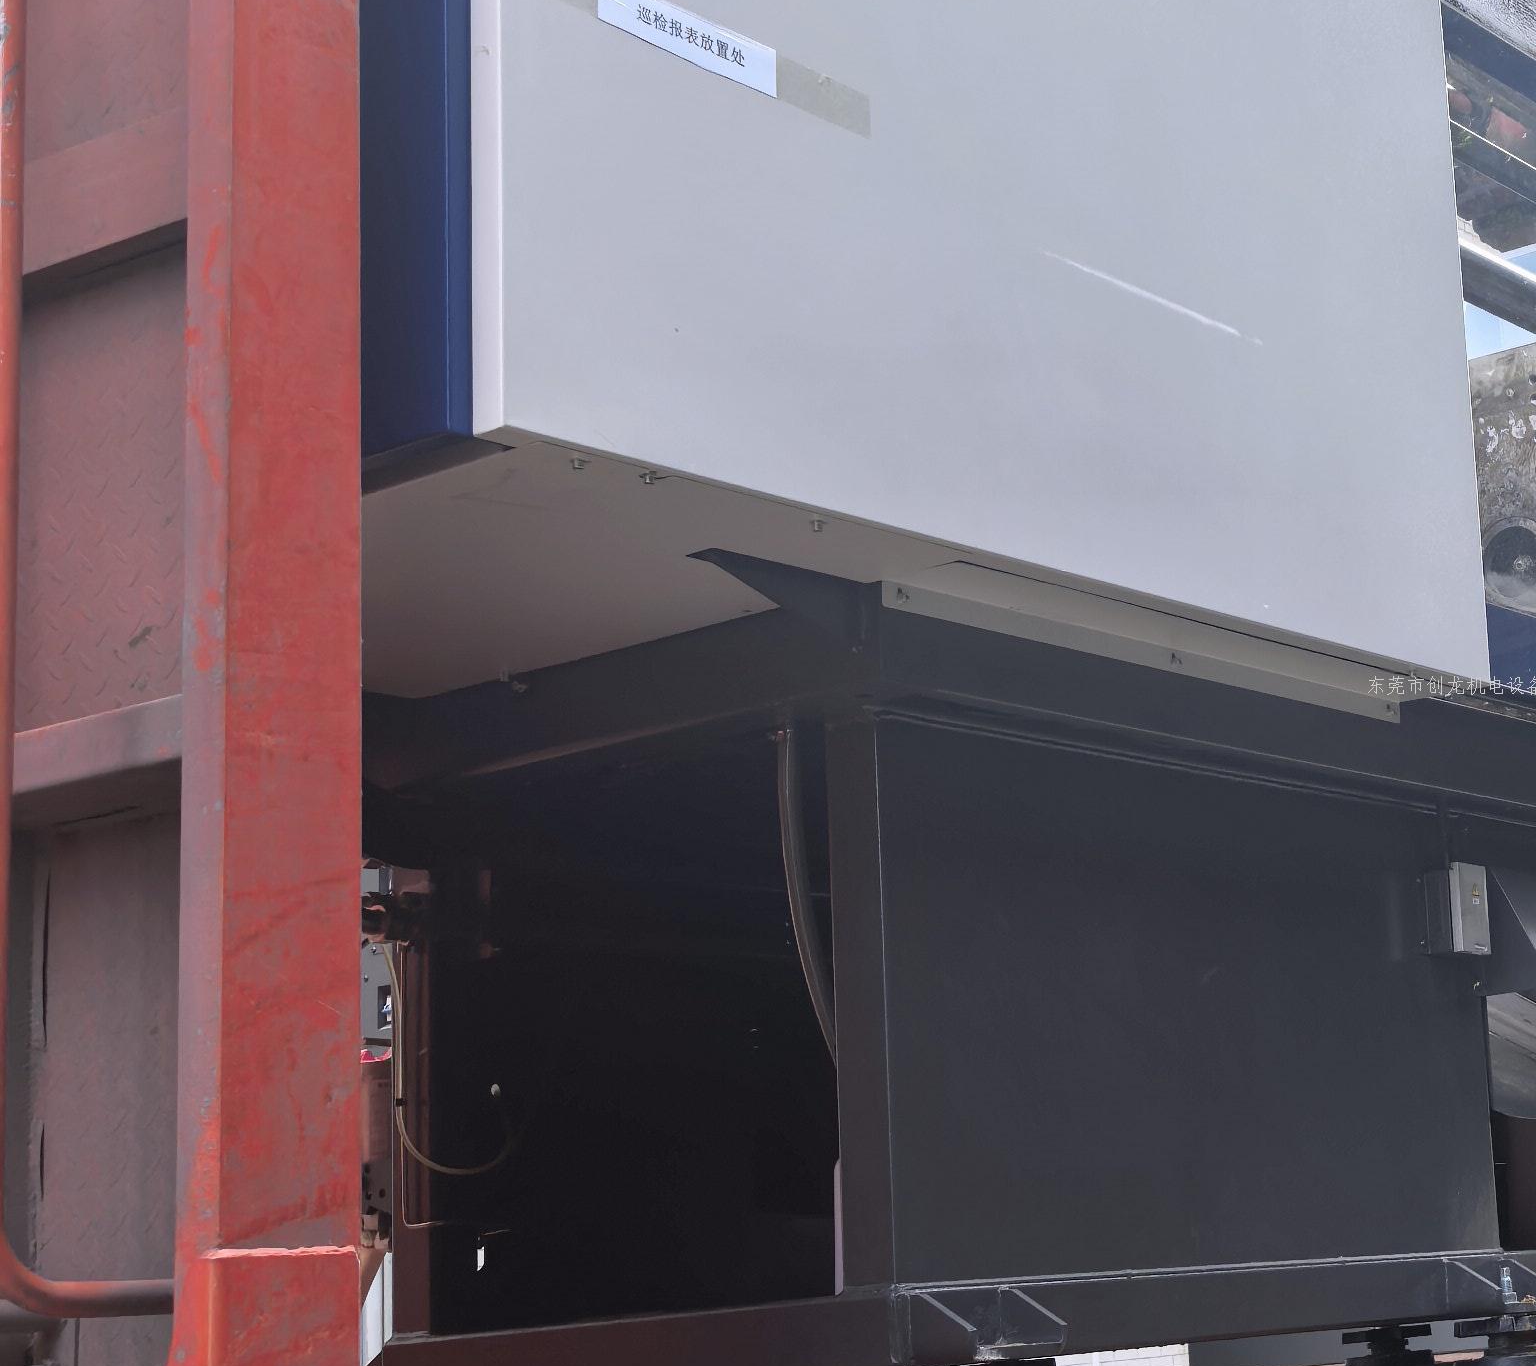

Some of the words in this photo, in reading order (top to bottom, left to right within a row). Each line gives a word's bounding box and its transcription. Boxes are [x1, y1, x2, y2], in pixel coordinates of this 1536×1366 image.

[636, 3, 746, 68] 巡检报表放置处
